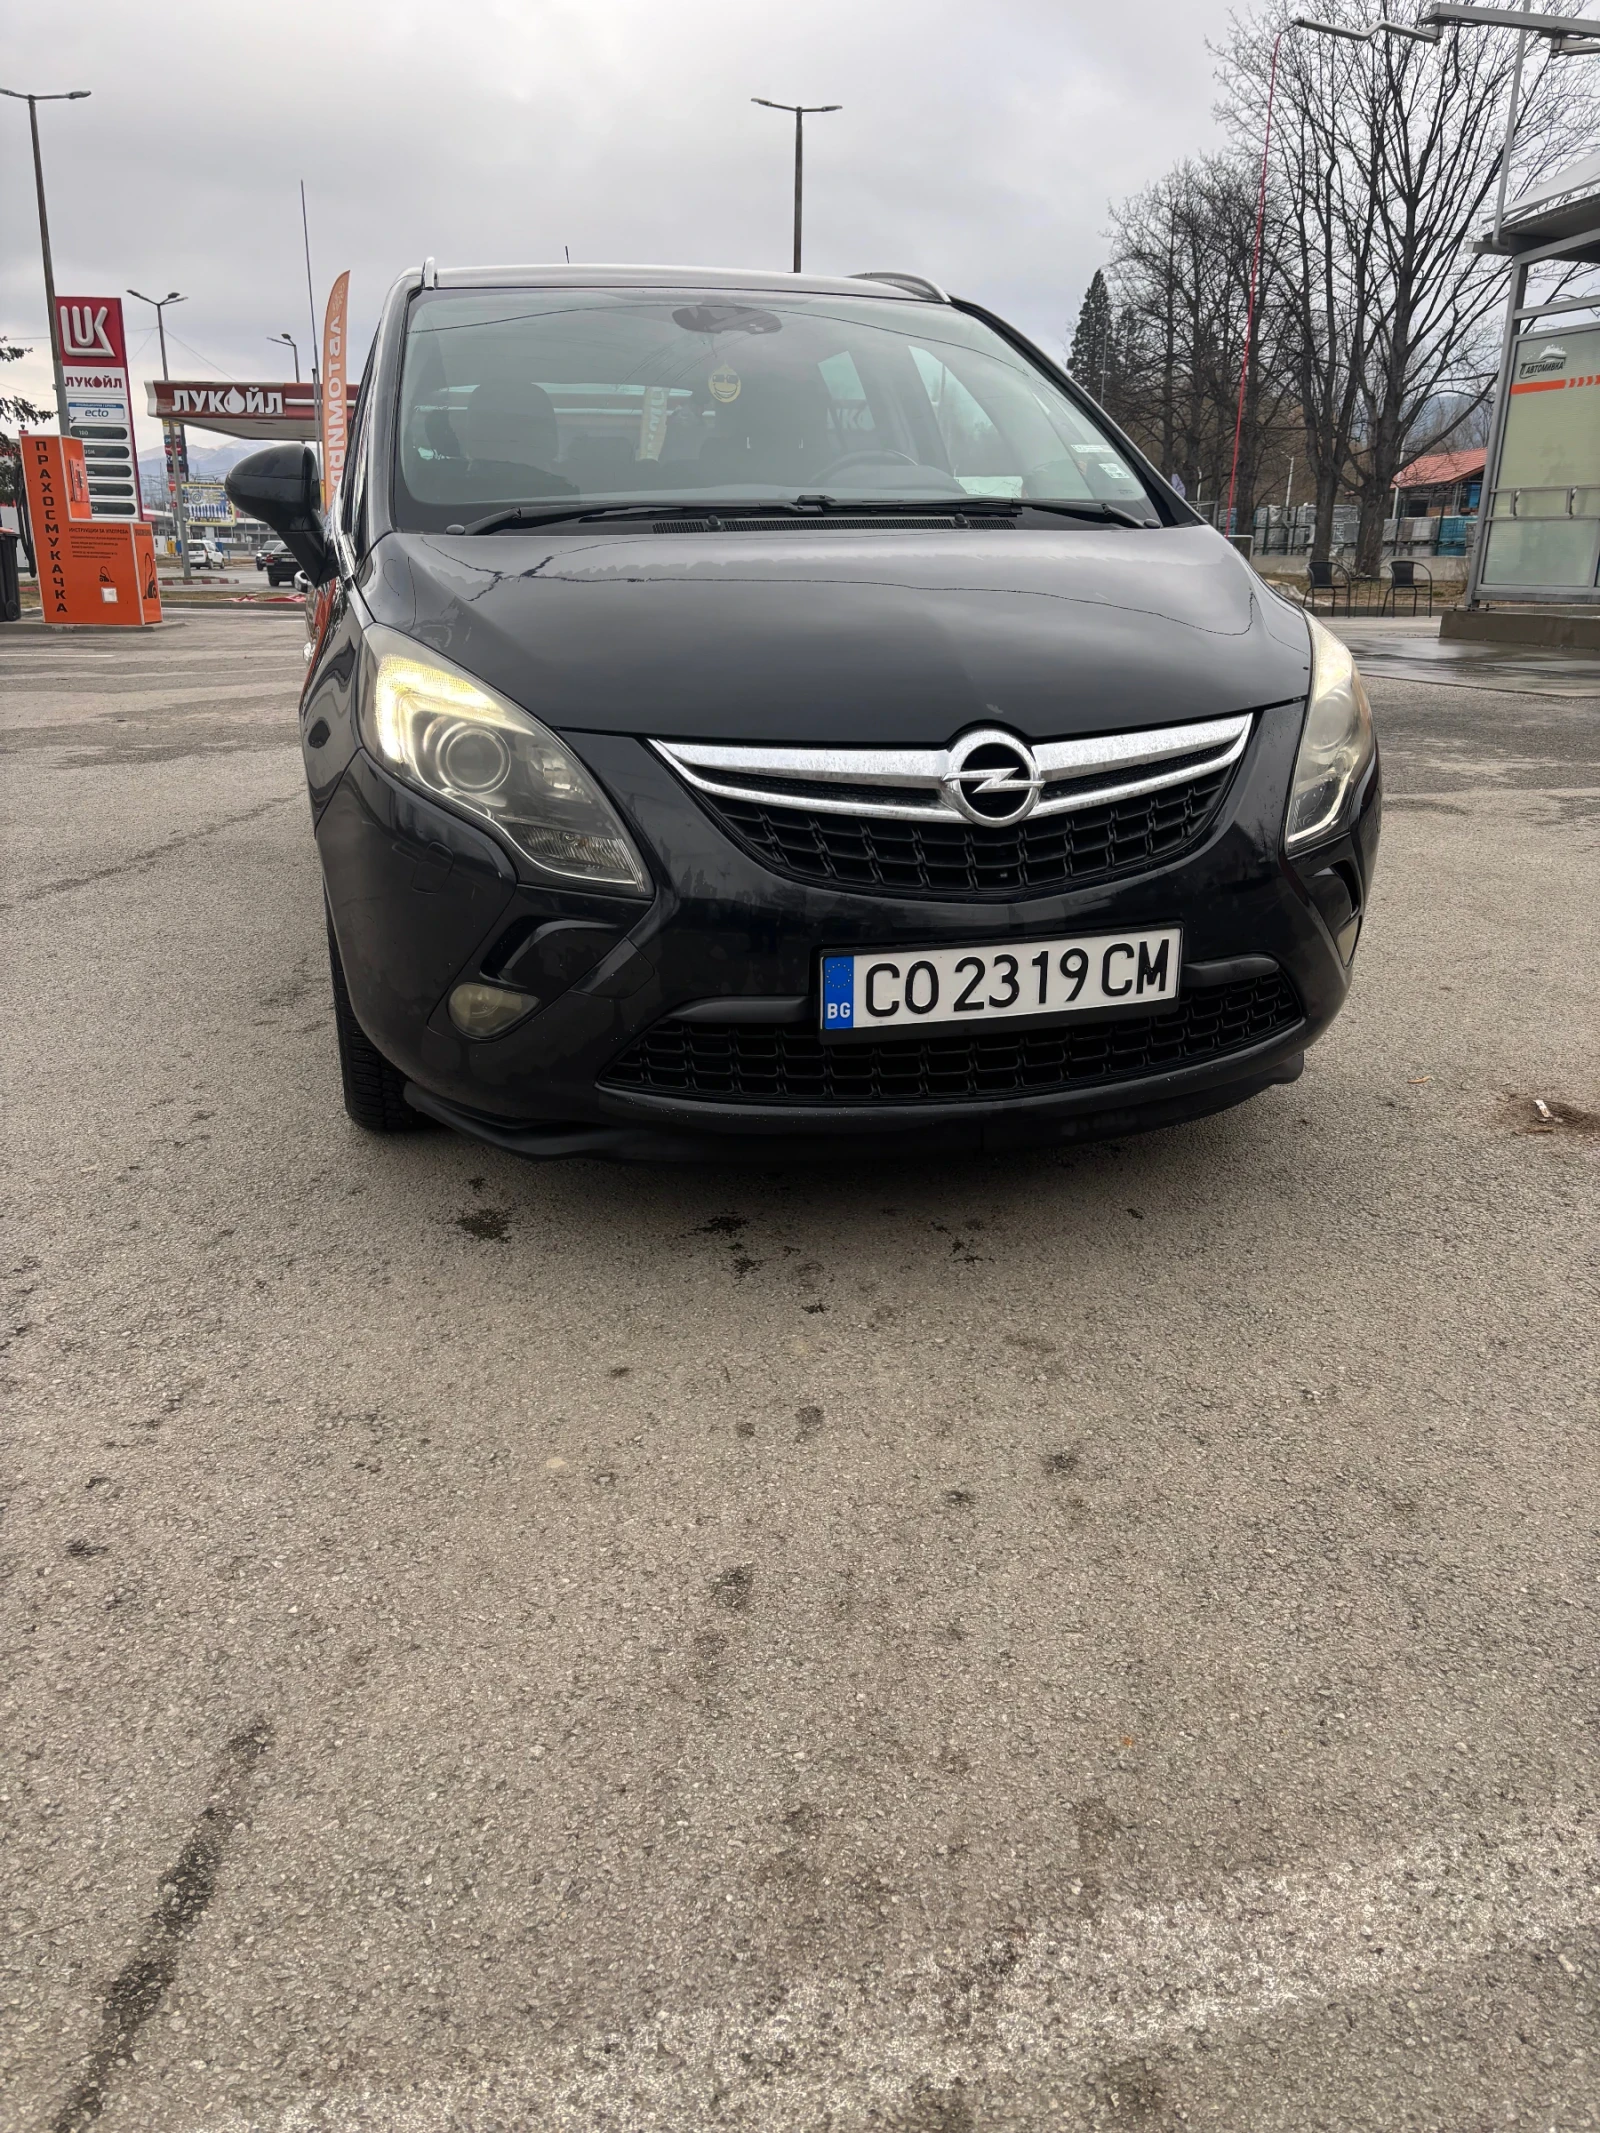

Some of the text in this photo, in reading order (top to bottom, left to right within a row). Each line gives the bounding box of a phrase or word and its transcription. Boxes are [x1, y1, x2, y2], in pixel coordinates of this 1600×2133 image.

[1525, 361, 1563, 374] АВТОМИВКА
[85, 408, 109, 417] ecto
[35, 441, 68, 613] ПРАХОСМУКАЧКА
[953, 948, 1089, 1012] 2319
[827, 1002, 850, 1019] BG
